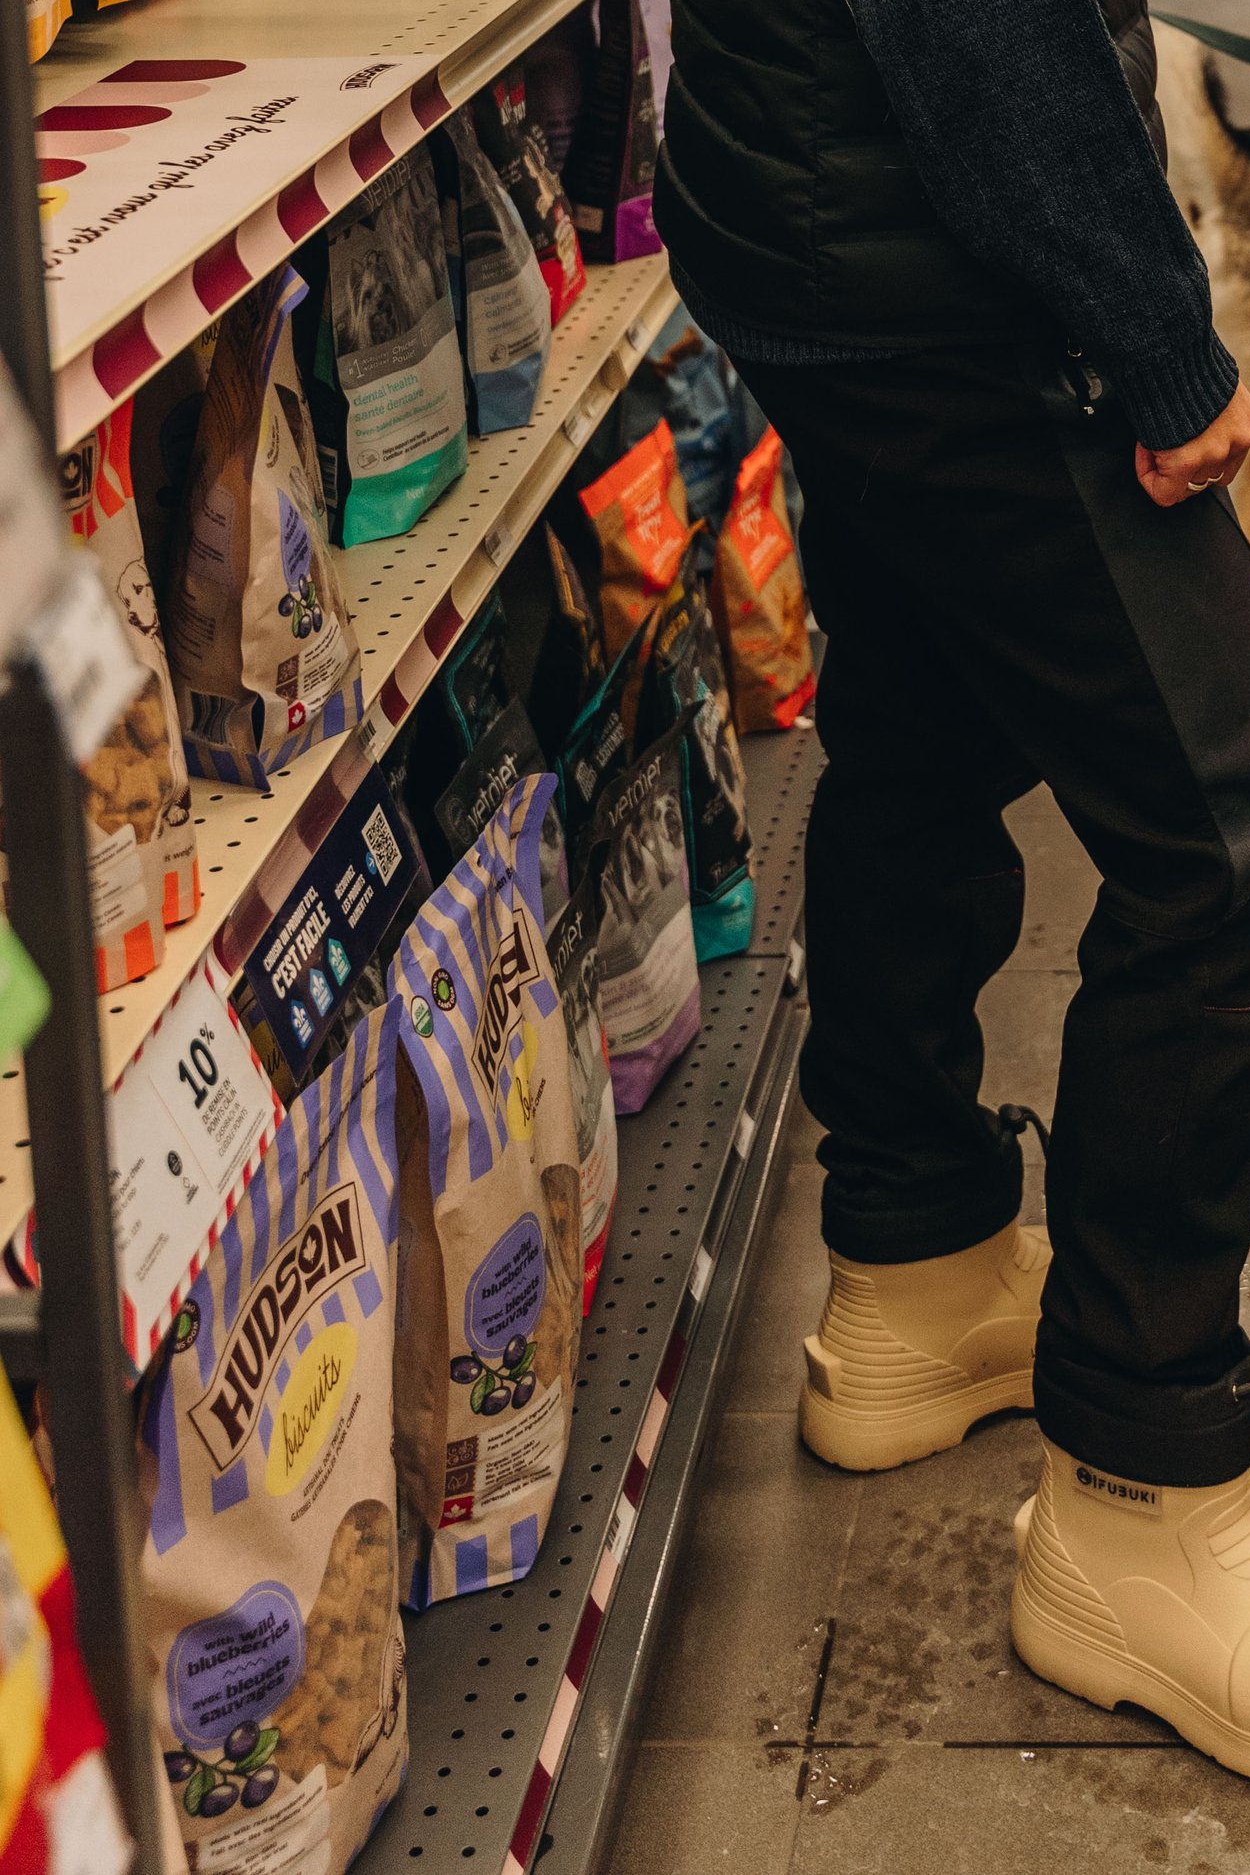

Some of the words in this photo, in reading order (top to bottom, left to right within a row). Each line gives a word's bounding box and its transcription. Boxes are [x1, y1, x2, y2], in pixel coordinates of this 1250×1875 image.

[353, 381, 383, 407] dental
[386, 372, 418, 396] health
[388, 384, 425, 414] dentaire
[262, 936, 283, 973] CHOISIR
[278, 927, 290, 946] UN
[284, 899, 308, 936] PRODUIT
[270, 943, 303, 1000] C'EST
[294, 899, 331, 962] FACILE
[554, 910, 583, 980] diet
[178, 1022, 220, 1111] 10%
[206, 1104, 225, 1135] POINTS
[207, 1086, 225, 1114] REMISE
[214, 1108, 236, 1142] CASHBACK
[218, 1128, 235, 1157] CUDDLE
[232, 1106, 248, 1132] POINTS
[481, 1243, 541, 1300] blueberries
[512, 1236, 533, 1260] wild
[486, 1293, 539, 1339] sauvages
[505, 1275, 541, 1312] bleuets
[208, 1197, 358, 1452] HUDSON
[282, 1352, 342, 1477] biscuits
[343, 1391, 362, 1428] CHIENS
[1098, 1478, 1156, 1505] FUBUKI
[186, 1618, 291, 1679] blueberries
[204, 1635, 236, 1652] with
[238, 1611, 277, 1642] wild
[191, 1691, 224, 1712] avec
[225, 1654, 291, 1699] bleuets
[199, 1673, 285, 1727] sauvages
